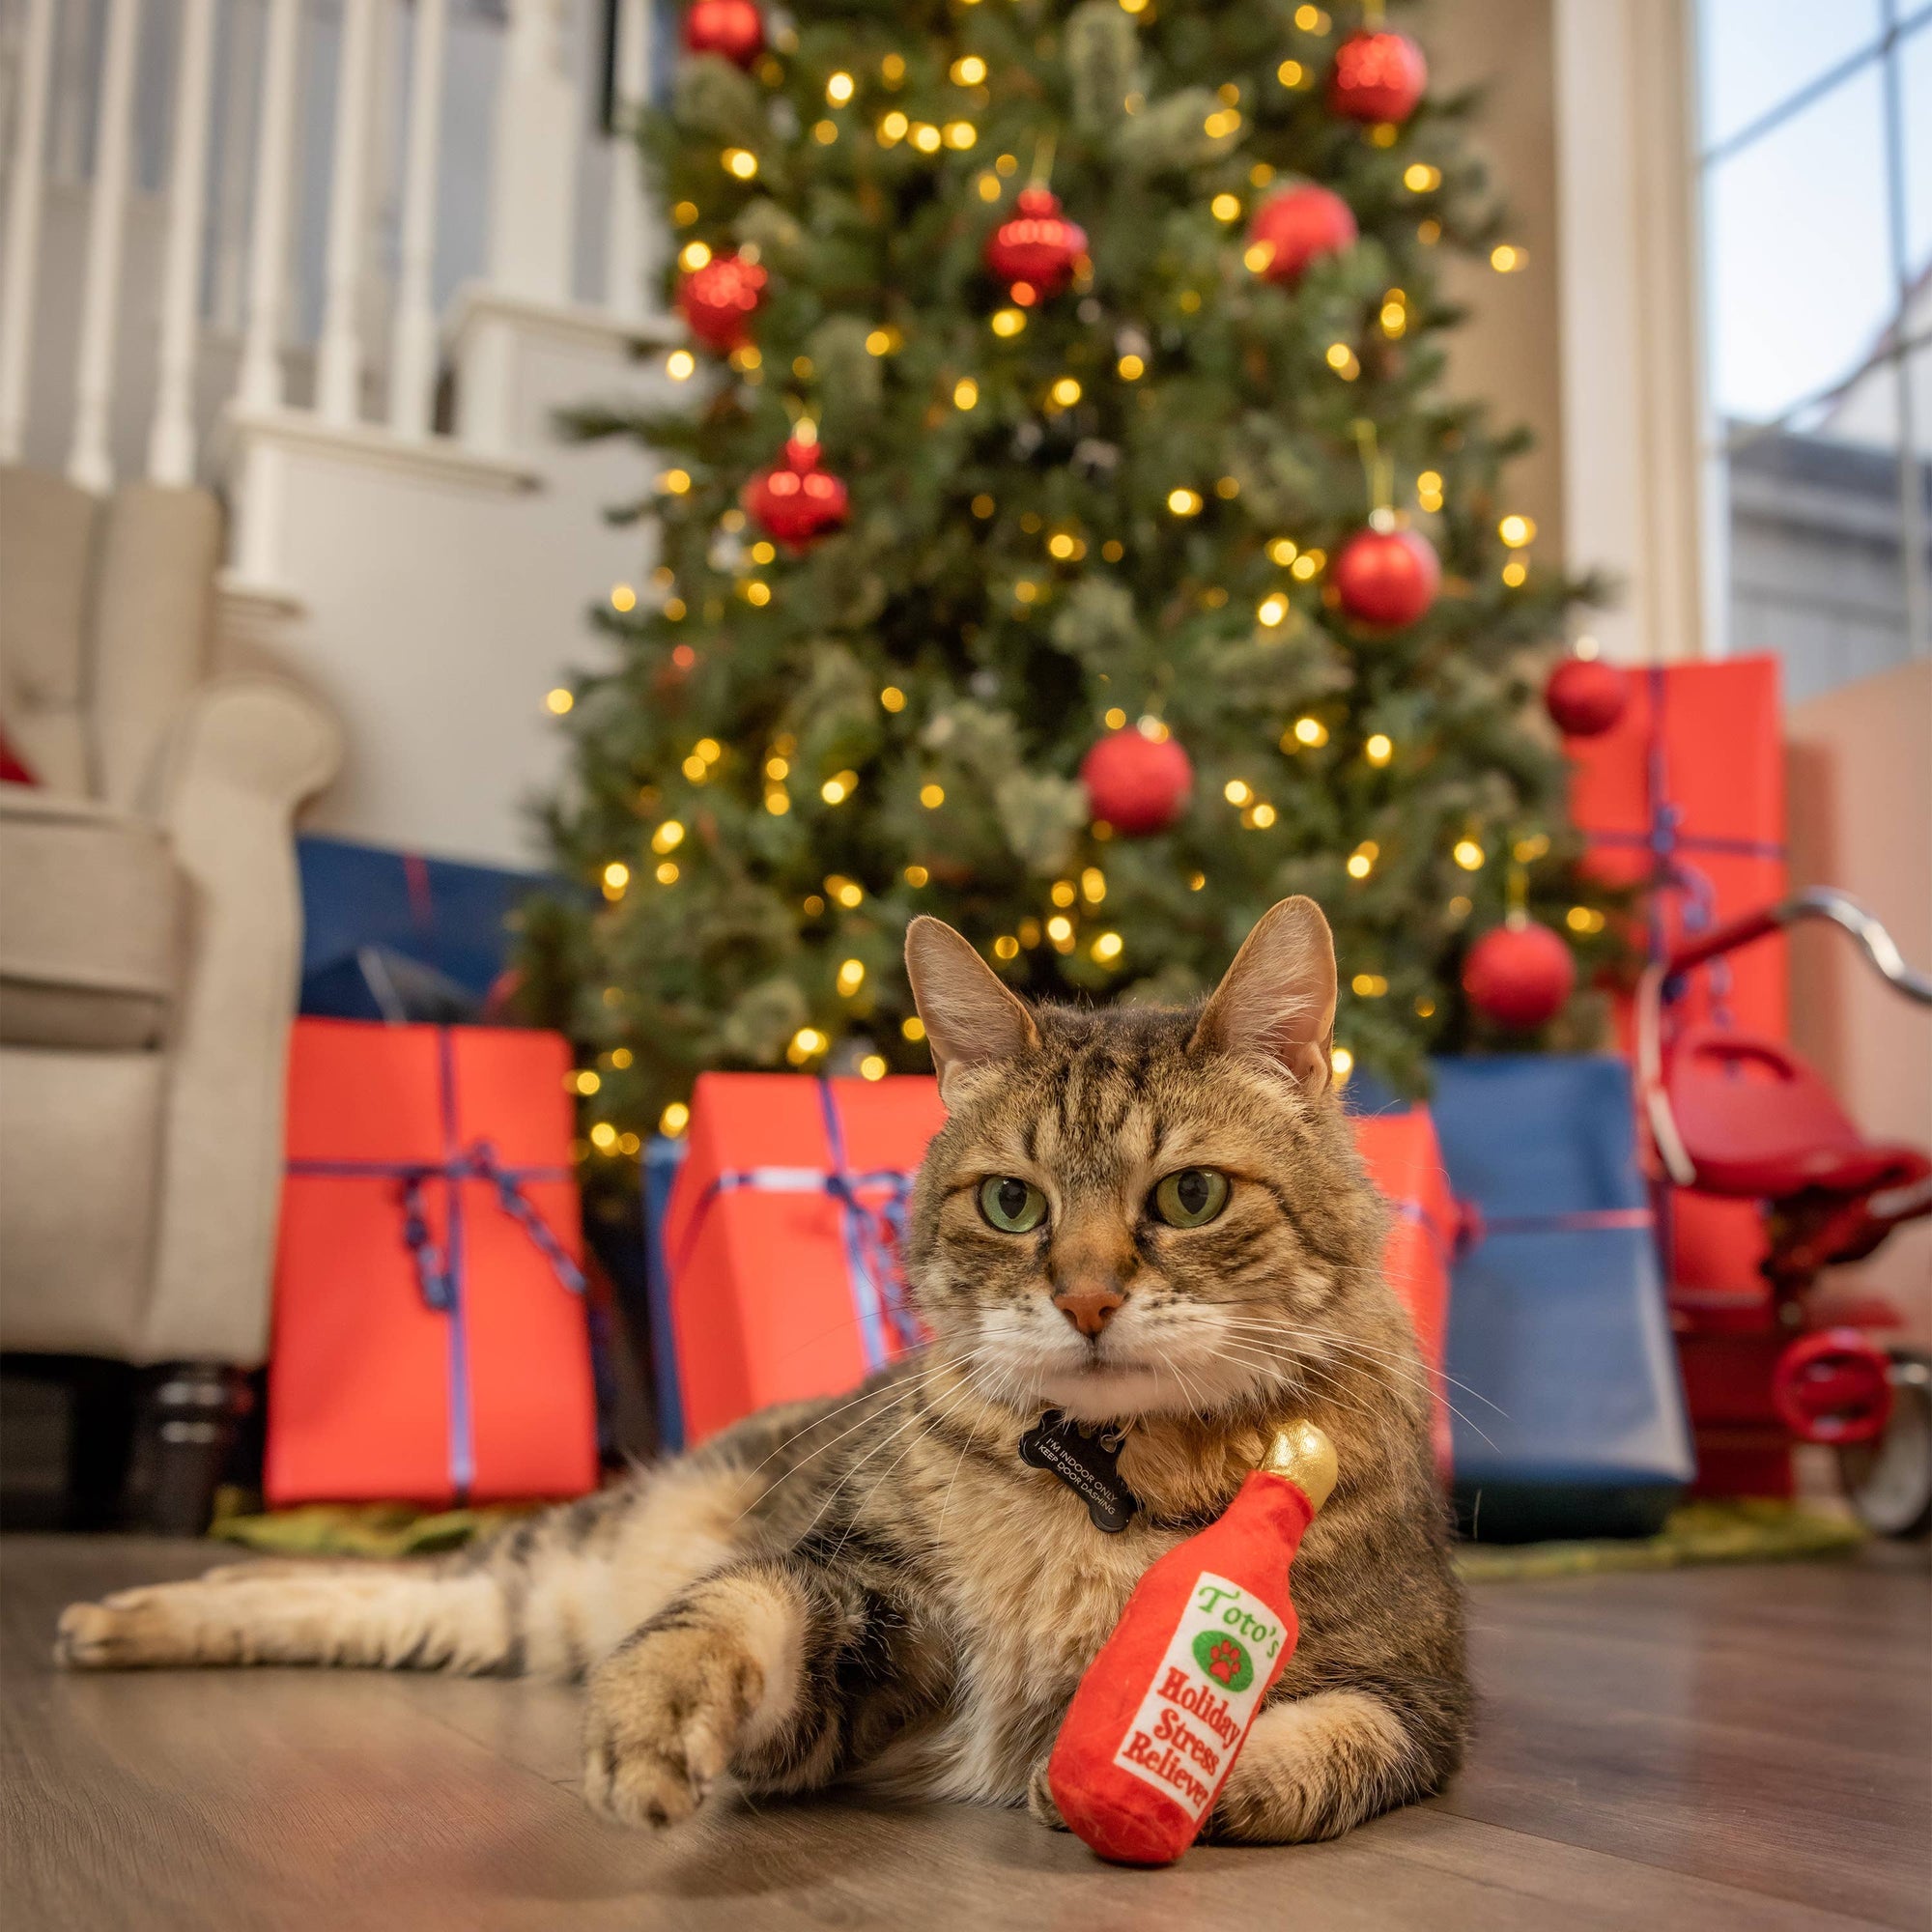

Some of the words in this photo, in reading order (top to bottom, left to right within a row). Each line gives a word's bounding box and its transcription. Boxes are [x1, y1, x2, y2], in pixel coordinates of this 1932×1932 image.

[1038, 1445, 1059, 1463] KEEP
[1057, 1461, 1082, 1485] DOOR
[1080, 1483, 1116, 1515] DASHING
[1046, 1437, 1061, 1452] I'M
[1060, 1450, 1095, 1484] INDOOR
[1094, 1481, 1118, 1502] ONLY
[1198, 1586, 1279, 1659] Toto's
[1153, 1708, 1220, 1776] Stress
[1157, 1666, 1241, 1750] Holiday
[1122, 1731, 1209, 1807] Reliever
